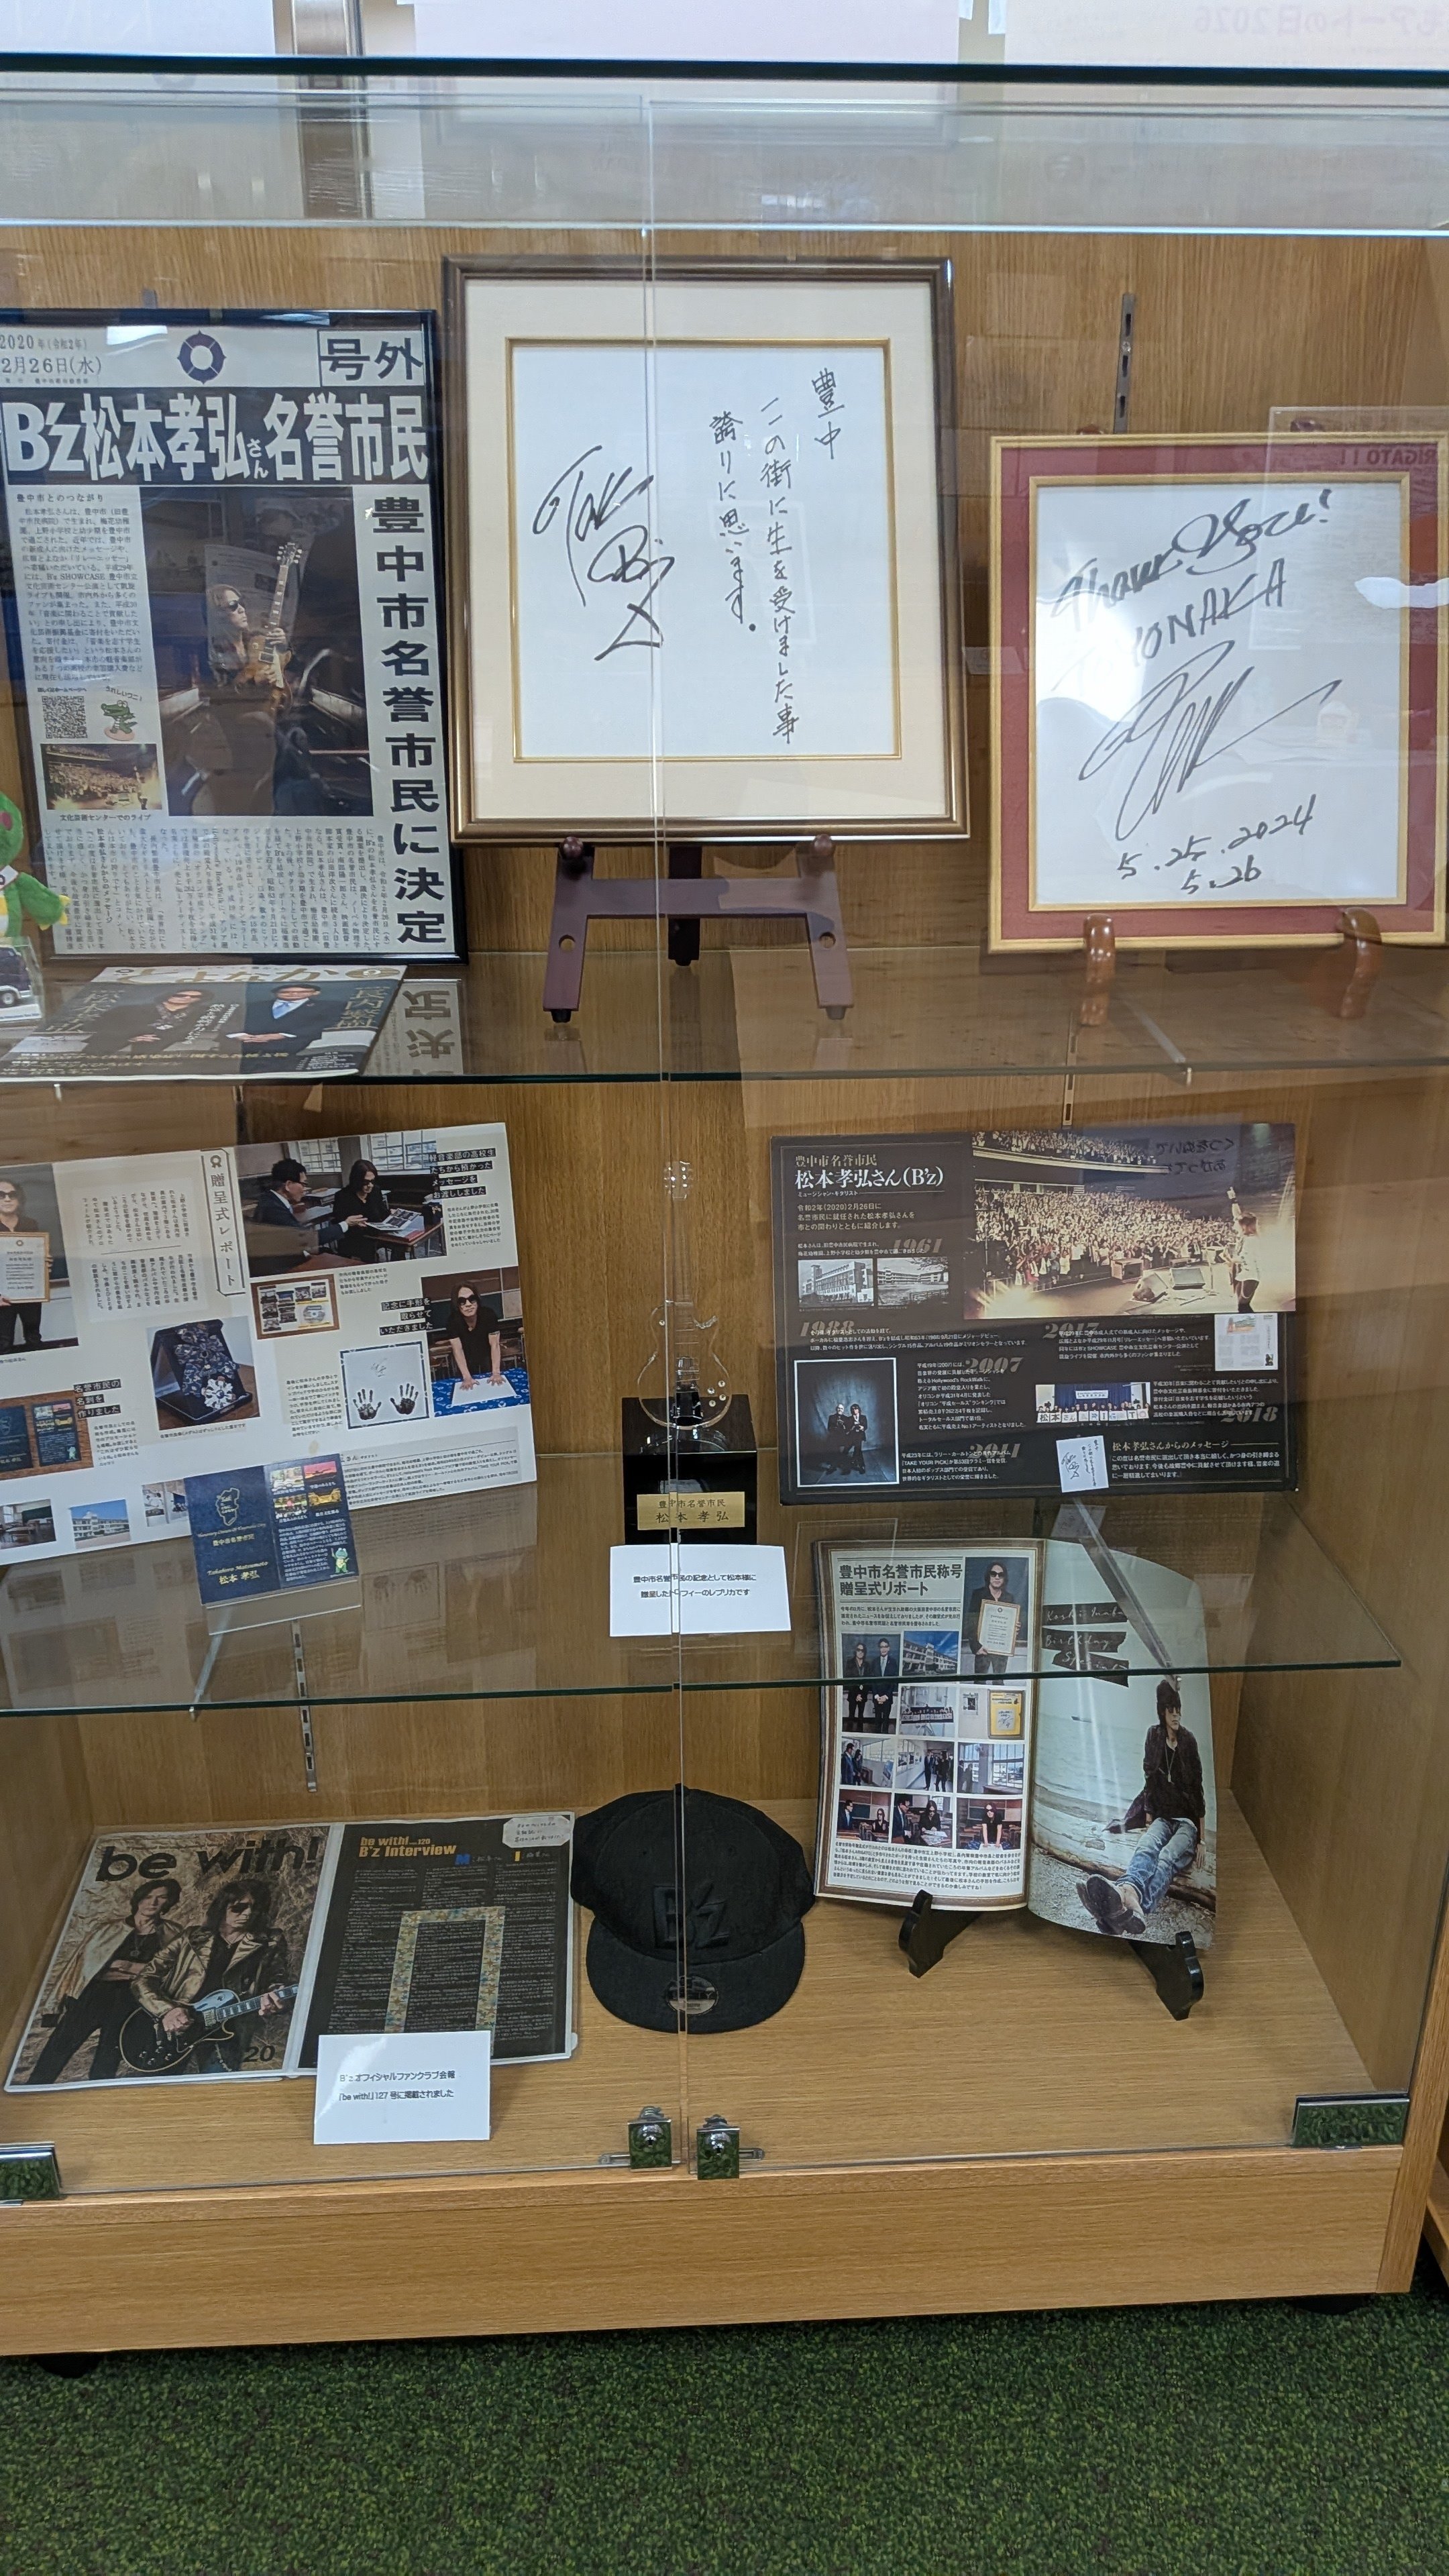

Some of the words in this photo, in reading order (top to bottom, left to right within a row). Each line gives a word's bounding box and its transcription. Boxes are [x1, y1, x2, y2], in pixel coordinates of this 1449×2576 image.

[320, 337, 423, 381] 号外
[812, 368, 845, 460] 豊中
[17, 493, 103, 502] 豊中市とのつながり
[709, 410, 757, 633] 誇りに思います。
[760, 397, 800, 744] この街に生を受けました事
[372, 496, 447, 945] 豊中市名誉市民に決定
[429, 1148, 494, 1162] 軽音楽部の高校生
[795, 1154, 877, 1167] 豊中市名誉市民
[431, 1162, 491, 1174] たちから預かった
[433, 1175, 476, 1186] メッセージを
[794, 1166, 944, 1189] 松本孝弘さん(B'z)
[433, 1187, 485, 1198] お渡ししました
[211, 1173, 235, 1287] 贈呈式レポート
[382, 1297, 430, 1310] 記念に手形を
[400, 1309, 431, 1321] 取らせて
[379, 1322, 433, 1336] いただきました
[964, 1357, 1024, 1373] 2007
[74, 1379, 121, 1393] 名誉市民の
[76, 1394, 104, 1406] 名刺を
[78, 1405, 121, 1419] 作りました
[657, 1499, 726, 1509] 豊中市名誉市民
[655, 1511, 729, 1523] 松本孝弘
[839, 1564, 963, 1580] 豊中市名誉市民称号
[840, 1580, 928, 1597] 贈呈式リポート
[360, 1837, 375, 1846] be
[359, 1846, 381, 1858] B'z
[384, 1844, 457, 1858] Interview
[95, 1845, 176, 1882] be
[197, 1835, 321, 1874] with!
